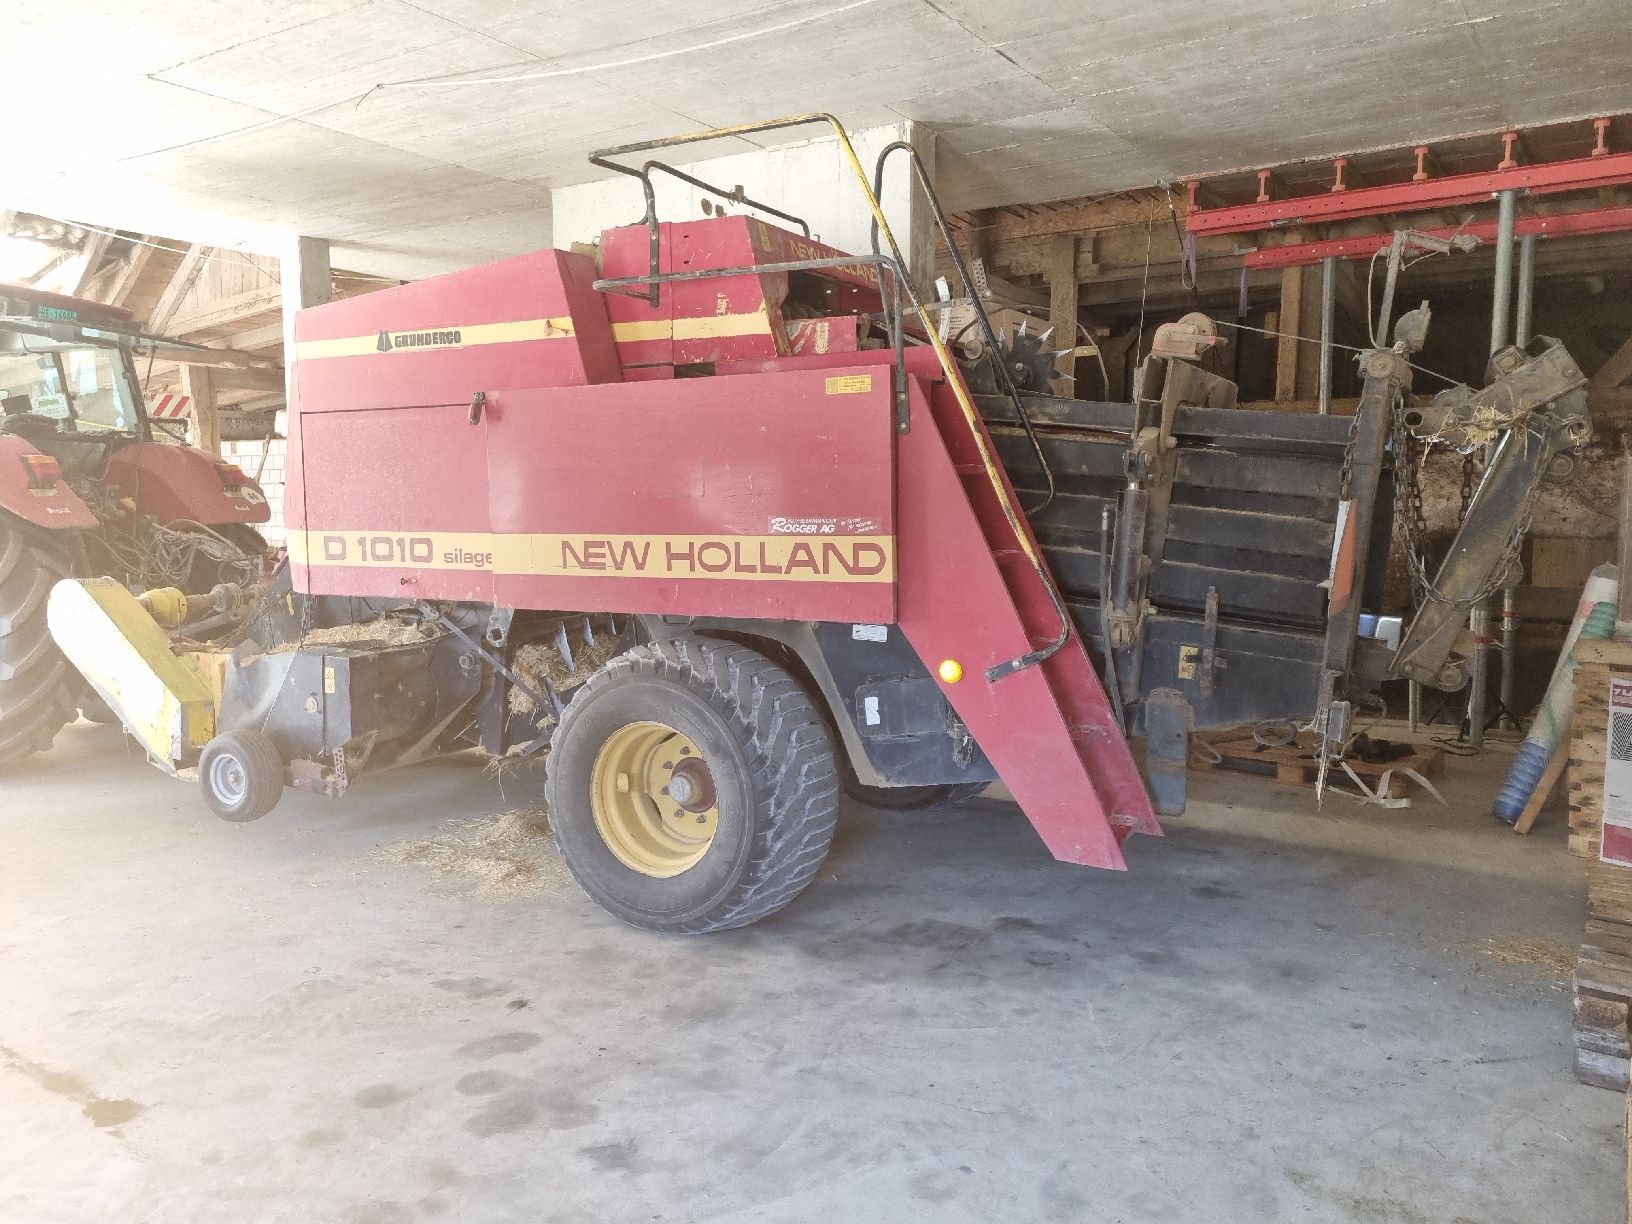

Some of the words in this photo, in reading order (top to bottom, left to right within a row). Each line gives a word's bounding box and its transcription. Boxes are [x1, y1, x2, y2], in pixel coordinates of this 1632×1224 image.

[394, 330, 462, 348] GRUNDERCO
[770, 517, 817, 533] ROGGER
[820, 524, 836, 533] AG
[323, 535, 347, 560] D
[356, 536, 434, 563] 1010
[443, 548, 493, 568] silage
[561, 540, 651, 571] NEW
[665, 541, 887, 576] HOLLAND
